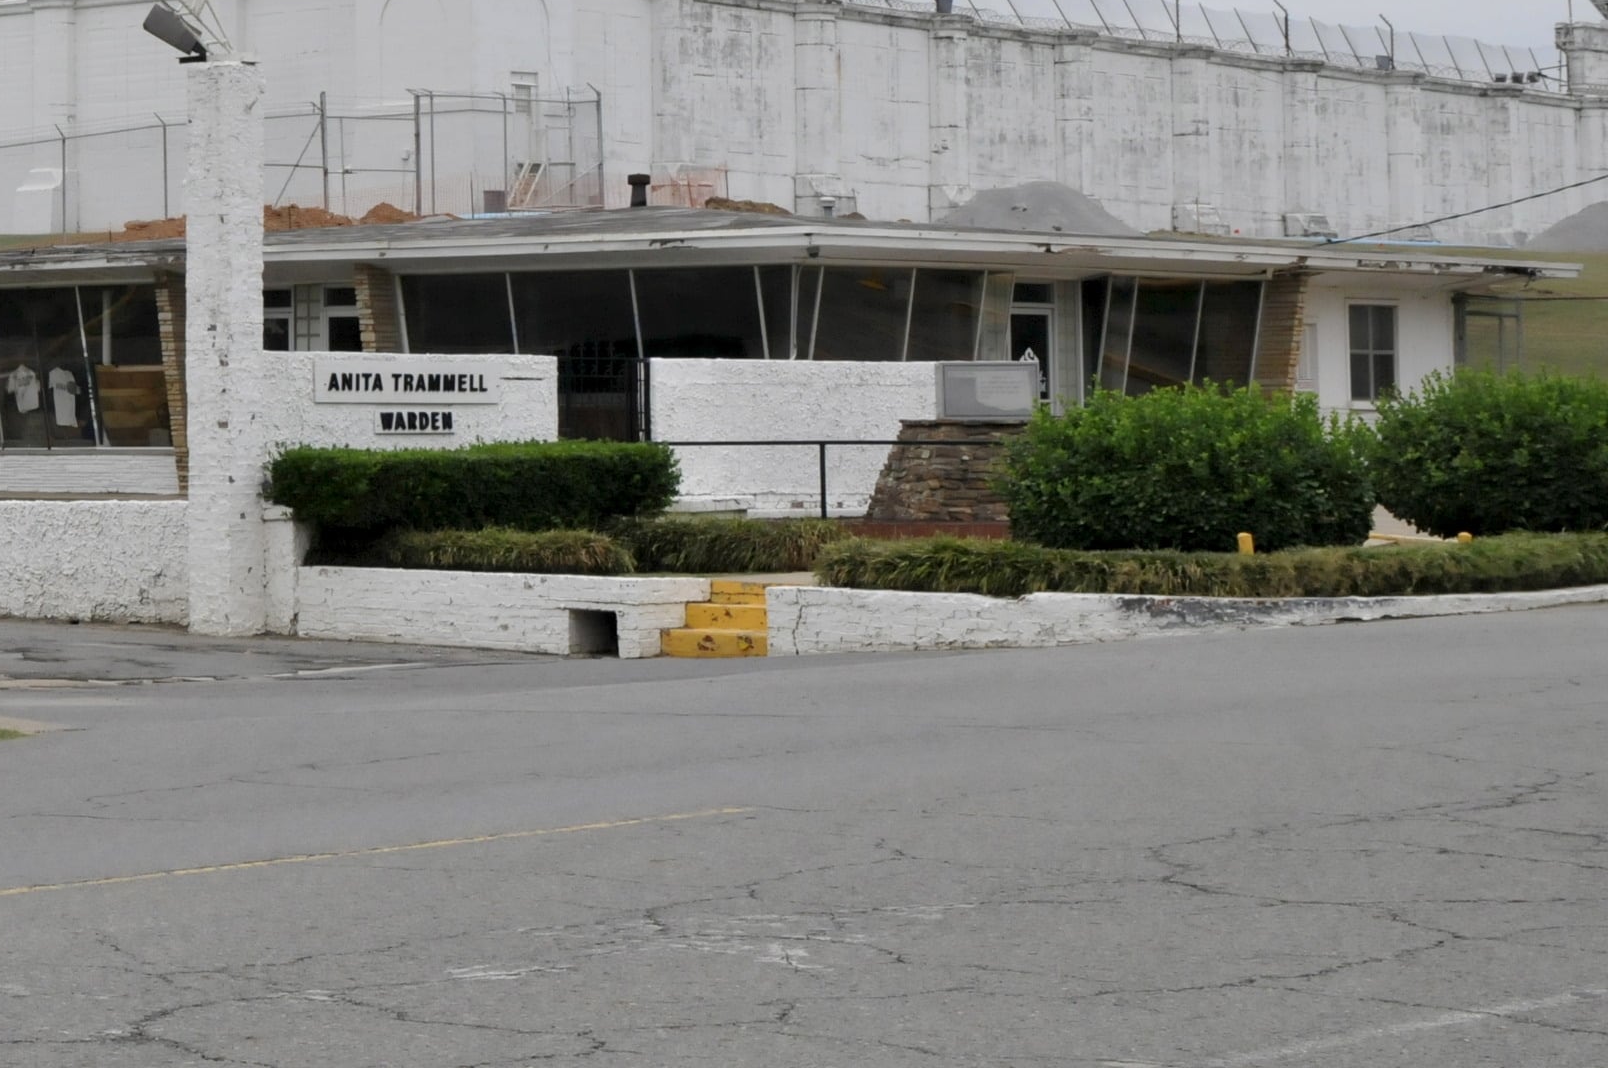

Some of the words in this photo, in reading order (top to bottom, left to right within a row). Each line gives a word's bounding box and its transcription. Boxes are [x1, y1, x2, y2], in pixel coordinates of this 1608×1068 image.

[328, 373, 383, 392] ANITA
[392, 373, 488, 392] TRAMMELL
[380, 412, 453, 431] WARDEN
